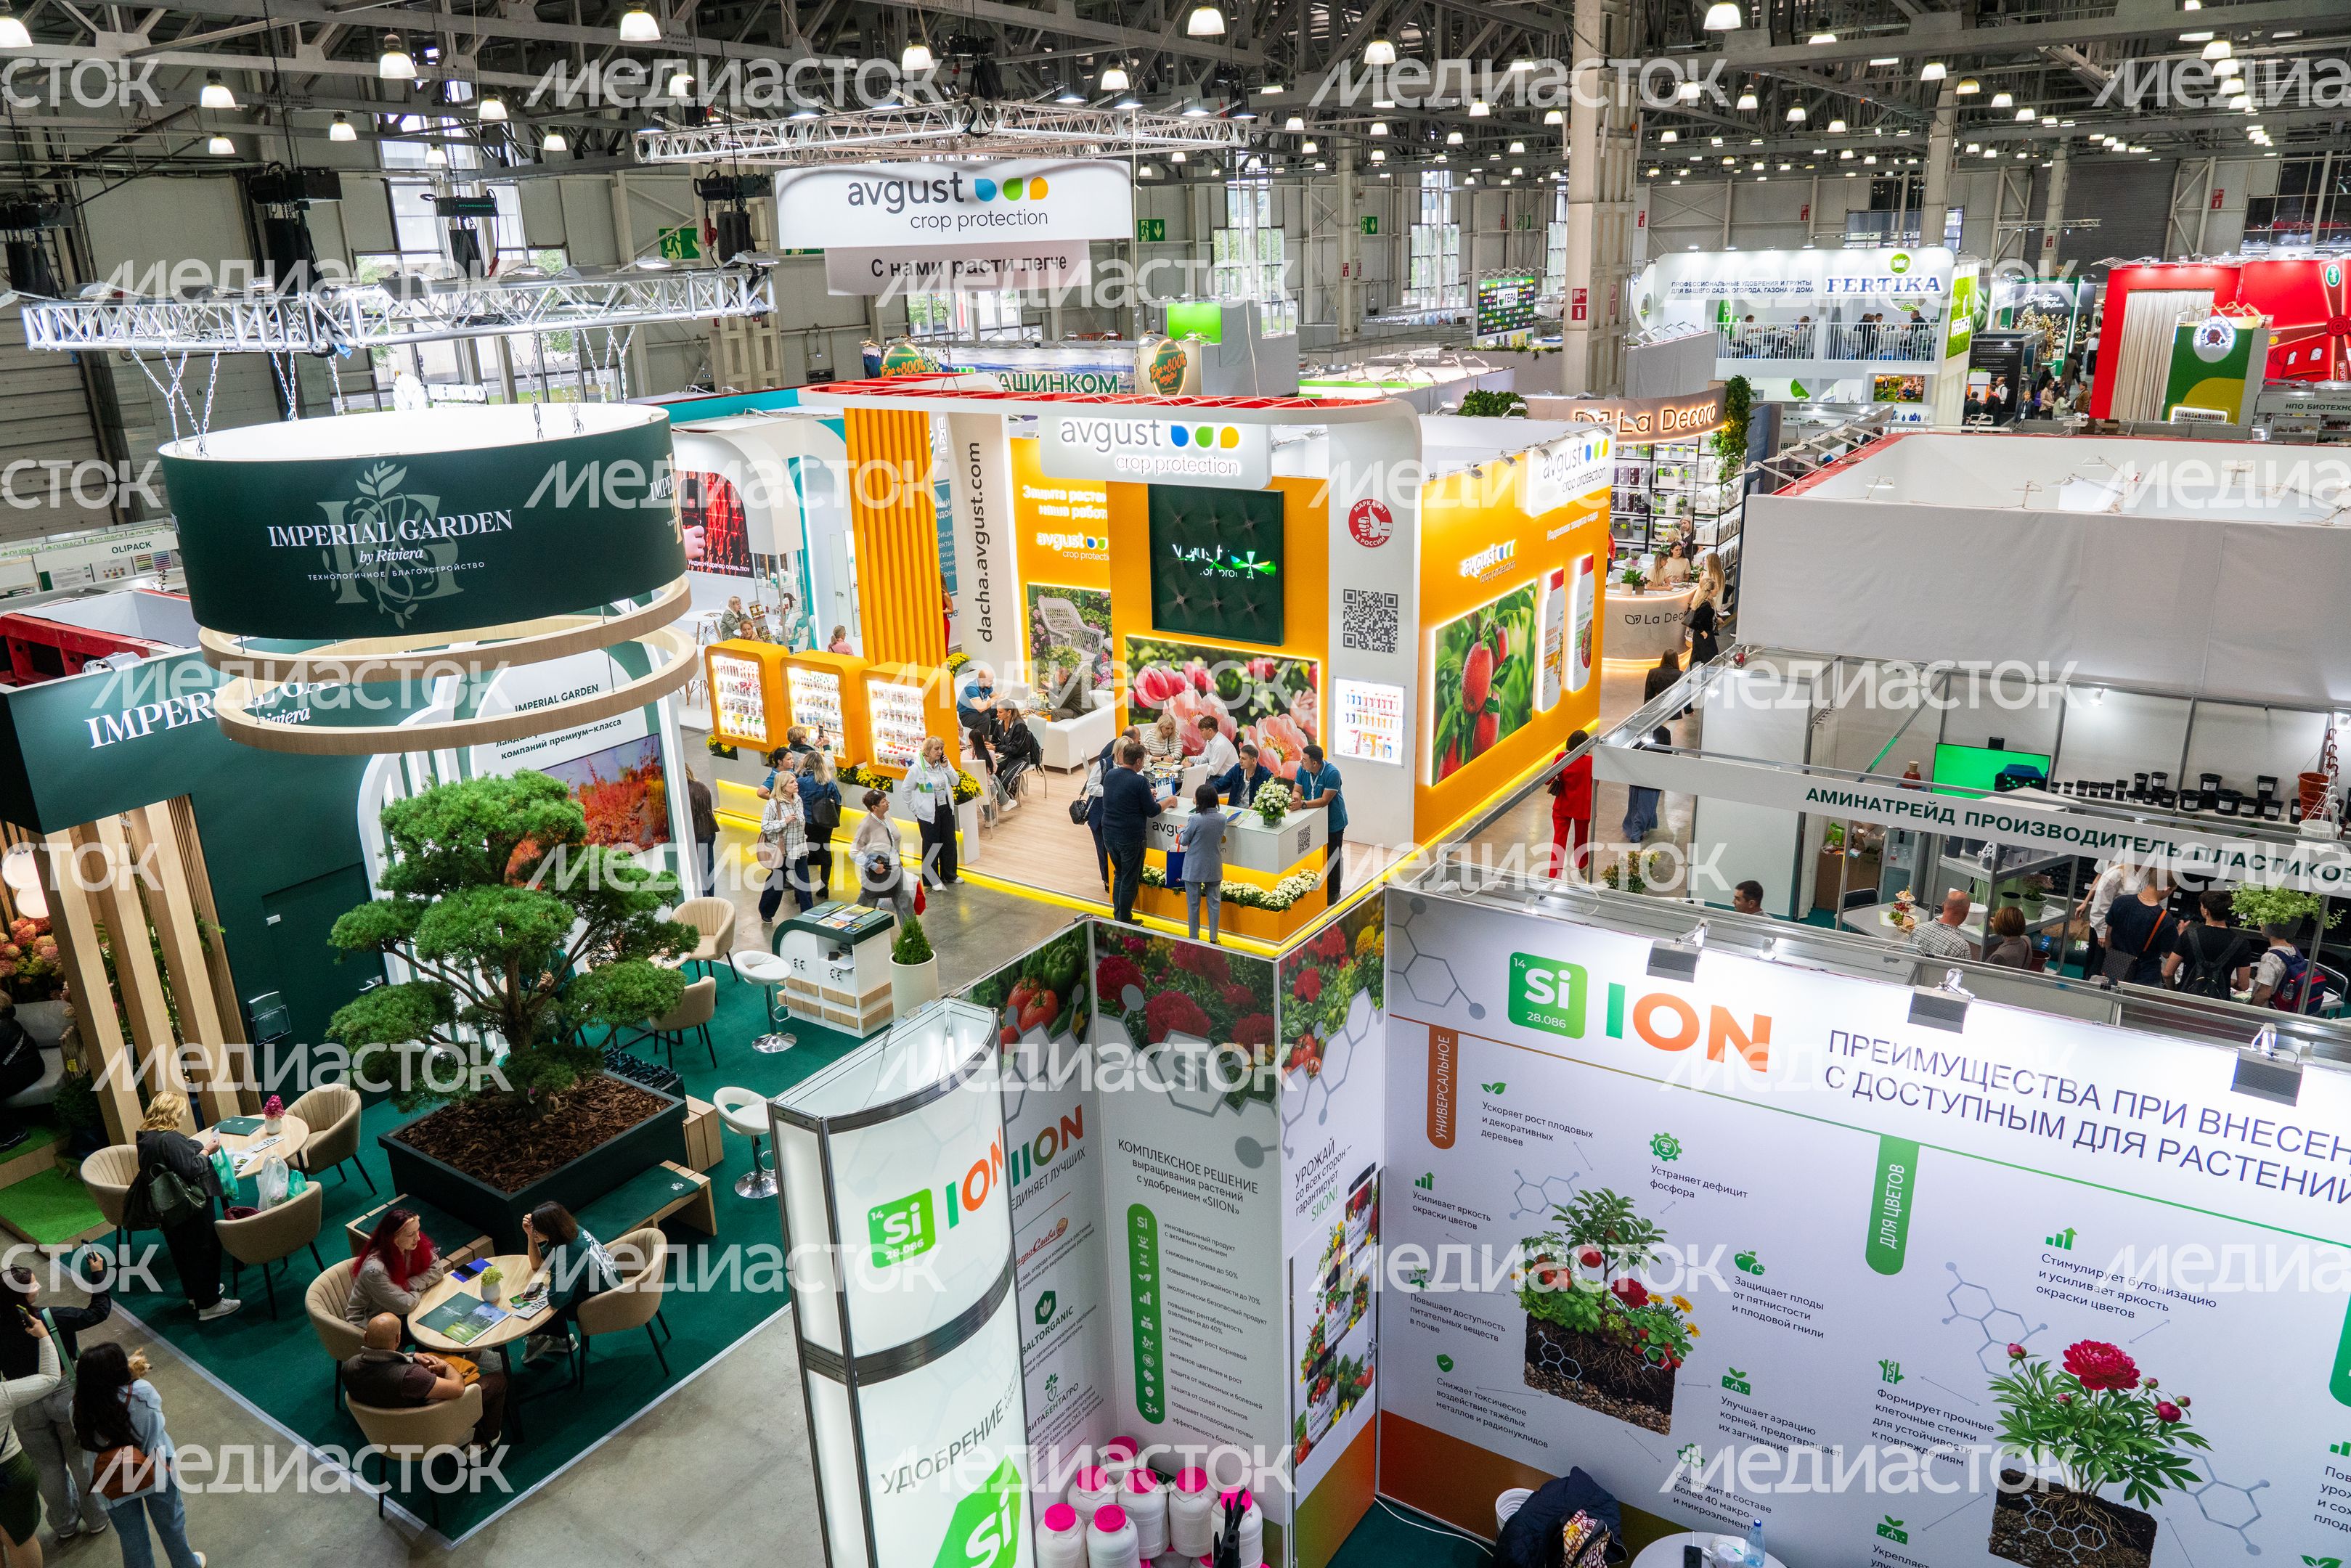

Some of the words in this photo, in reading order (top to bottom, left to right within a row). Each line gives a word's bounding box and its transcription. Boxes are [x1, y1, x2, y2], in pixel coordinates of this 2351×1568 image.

[848, 172, 965, 213] avgust
[910, 214, 951, 232] crop
[958, 208, 1048, 232] protection
[871, 259, 884, 277] С
[891, 261, 943, 277] нами
[952, 260, 1014, 279] расти
[1021, 256, 1067, 273] легче
[1826, 277, 1942, 293] FERTIKA
[1619, 410, 1652, 433] La
[1662, 401, 1717, 431] Decoro
[1059, 420, 1161, 454] avgust
[1116, 456, 1151, 475] crop
[1154, 455, 1239, 476] protection
[1544, 441, 1582, 481] avgust
[1022, 484, 1067, 501] Защита
[1354, 500, 1376, 513] МАРКА
[1038, 505, 1069, 517] наша
[266, 518, 394, 548] IMPERIAL
[399, 510, 514, 542] GARDEN
[969, 442, 993, 643] dacha.avgust.com
[1036, 532, 1085, 551] avgust
[1360, 536, 1386, 546] РОССИИ
[112, 541, 152, 554] OLIPACK
[359, 550, 374, 565] by
[375, 547, 424, 563] Riviera
[1063, 551, 1079, 560] crop
[308, 568, 386, 582] ТЕХНОЛОГИЧНОЕ
[391, 560, 485, 579] БЛАГОУСТРОЙСТВО
[1645, 614, 1660, 624] La
[515, 695, 558, 712] IMPERIAL
[561, 684, 599, 703] GARDEN
[501, 741, 547, 759] компаний
[1805, 786, 1956, 827] АМИНАТРЕЙД
[1965, 809, 2181, 862] ПРОИЗВОДИТЕЛЬ
[1513, 957, 1526, 969] 14
[1524, 967, 1571, 1010] Si
[1606, 981, 1772, 1073] ION
[1526, 1011, 1567, 1029] 28.086
[1435, 1034, 1451, 1141] УНИВЕРСАЛЬНОЕ
[1829, 1029, 2102, 1111] ПРЕИМУЩЕСТВА
[2112, 1087, 2188, 1130] ПРИ
[1482, 1101, 1523, 1123] Ускоряет
[1524, 1112, 1546, 1127] рост
[1548, 1118, 1594, 1139] плодовых
[1826, 1066, 1846, 1090] С
[1852, 1073, 2066, 1143] ДОСТУПНЫМ
[2074, 1122, 2146, 1161] ДЛЯ
[1481, 1130, 1523, 1147] деревьев
[1489, 1119, 1554, 1143] декоративных
[1049, 1146, 1086, 1183] ЛУЧШИХ
[1118, 1138, 1202, 1176] КОМПЛЕКСНОЕ
[1204, 1166, 1259, 1194] РЕШЕНИЕ
[1295, 1136, 1335, 1188] УРОЖАЙ
[1295, 1188, 1305, 1201] со
[1305, 1172, 1321, 1193] всех
[1321, 1148, 1346, 1177] сторон
[1132, 1159, 1196, 1187] выращивания
[1198, 1180, 1244, 1202] растений
[1144, 1177, 1200, 1204] удобрением
[1295, 1169, 1339, 1217] гарантирует
[1650, 1165, 1701, 1188] Устраняет
[1703, 1178, 1748, 1199] дефицит
[1650, 1179, 1695, 1199] фосфора
[1882, 1164, 1905, 1217] ЦВЕТОВ
[870, 1210, 884, 1222] 14
[1412, 1204, 1446, 1223] окраски
[1448, 1214, 1478, 1231] цветов
[1413, 1191, 1456, 1213] Усиливает
[1457, 1205, 1491, 1223] яркость
[882, 1202, 922, 1248] Si
[1164, 1222, 1211, 1244] инновационный
[1212, 1238, 1236, 1252] продукт
[1879, 1218, 1897, 1249] ДЛЯ
[885, 1238, 925, 1262] 28.086
[1165, 1249, 1194, 1264] снижение
[1194, 1259, 1216, 1272] полива
[1169, 1233, 1197, 1247] активным
[1197, 1243, 1228, 1258] кремнием
[1166, 1266, 1199, 1283] повышение
[1199, 1278, 1239, 1298] урожайности
[1734, 1275, 1788, 1302] Защищает
[1790, 1294, 1824, 1310] плоды
[2041, 1253, 2126, 1287] Стимулирует
[2127, 1275, 2217, 1310] бутонизацию
[2049, 1275, 2116, 1299] усиливает
[2118, 1291, 2170, 1314] яркость
[1410, 1293, 1453, 1318] Повышает
[1454, 1307, 1507, 1333] доступность
[1733, 1291, 1743, 1300] от
[1745, 1296, 1812, 1320] пятнистости
[2036, 1287, 2088, 1310] окраски
[2090, 1302, 2135, 1320] цветов
[1409, 1306, 1462, 1331] питательных
[1463, 1325, 1499, 1343] веществ
[1416, 1320, 1441, 1335] почве
[1740, 1308, 1790, 1331] плодовой
[1793, 1324, 1825, 1339] гнили
[1721, 1396, 1769, 1422] Улучшает
[1770, 1413, 1816, 1437] аэрацию
[1875, 1404, 1935, 1429] клеточные
[1938, 1424, 1977, 1442] стенки
[1877, 1388, 1941, 1416] Формирует
[1943, 1410, 1995, 1433] прочные
[881, 1399, 1004, 1494] УДОБРЕНИЕ
[1719, 1410, 1759, 1431] корней,
[1760, 1424, 1842, 1458] предотвращает
[1719, 1424, 1730, 1433] их
[1732, 1428, 1790, 1453] загнивание
[1873, 1417, 1893, 1430] для
[1894, 1423, 1972, 1455] устойчивости
[1880, 1433, 1964, 1467] повреждениям
[1873, 1544, 1931, 1568] Укрепляет
